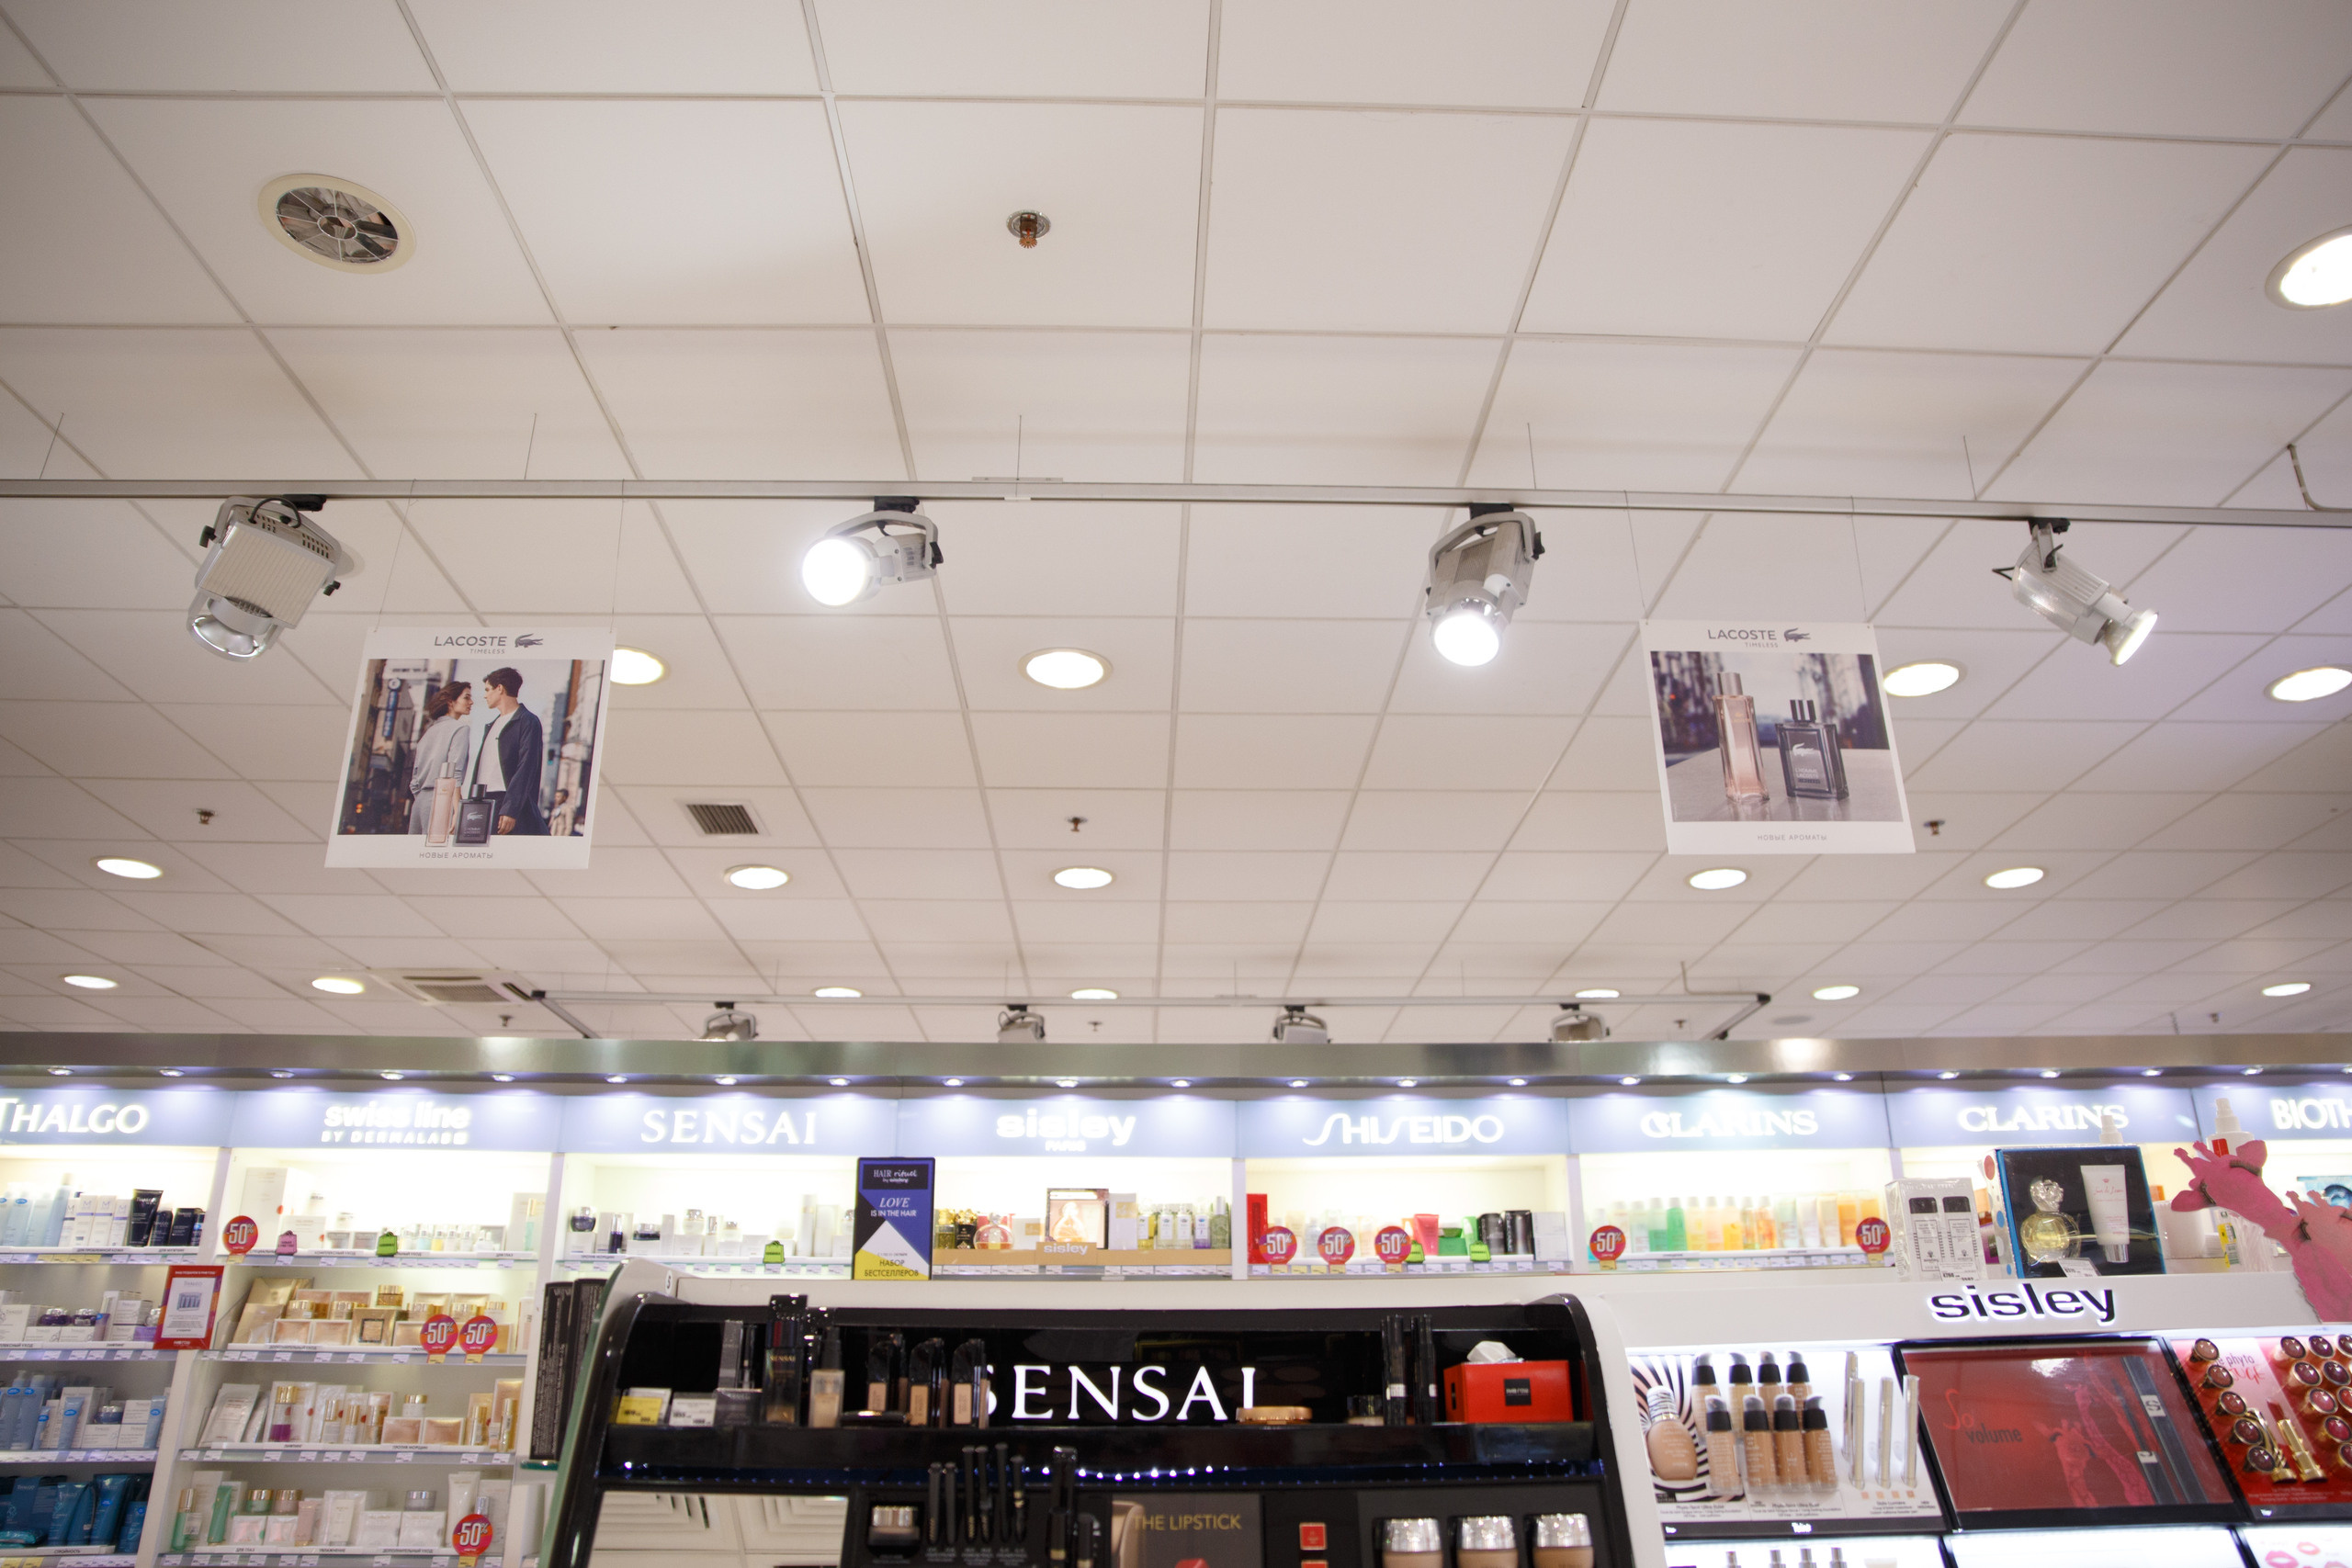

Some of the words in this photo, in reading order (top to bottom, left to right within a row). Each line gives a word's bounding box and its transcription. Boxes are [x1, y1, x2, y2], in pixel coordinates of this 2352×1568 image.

[434, 636, 507, 647] LACOSTE
[1707, 629, 1777, 640] LACOSTE
[0, 1098, 148, 1134] THALGO
[324, 1101, 412, 1128] swiss
[414, 1101, 472, 1129] line
[1640, 1110, 1819, 1138] CLARINS
[1957, 1105, 2130, 1132] CLARINS
[322, 1131, 344, 1143] BY
[641, 1110, 817, 1145] SENSAI
[996, 1108, 1136, 1146] sisley
[1302, 1112, 1505, 1146] SHISEIDO
[873, 1169, 892, 1178] HAIR
[893, 1169, 917, 1178] rituel
[879, 1197, 910, 1208] LOVE
[225, 1223, 254, 1246] -50%
[1264, 1233, 1294, 1255] -50%
[1322, 1233, 1351, 1255] -50%
[1379, 1233, 1407, 1255] -50%
[1594, 1232, 1622, 1253] -50%
[1860, 1224, 1887, 1246] -50%
[1043, 1243, 1089, 1256] sisley
[1929, 1282, 2116, 1325] sisley
[425, 1322, 454, 1345] -50%
[466, 1323, 493, 1345] -50%
[2225, 1353, 2256, 1368] phyto
[1942, 1388, 1974, 1430] So
[1965, 1423, 2022, 1444] volume
[1133, 1515, 1166, 1530] THE
[1169, 1514, 1242, 1530] LIPSTICK
[458, 1522, 488, 1546] -50%
